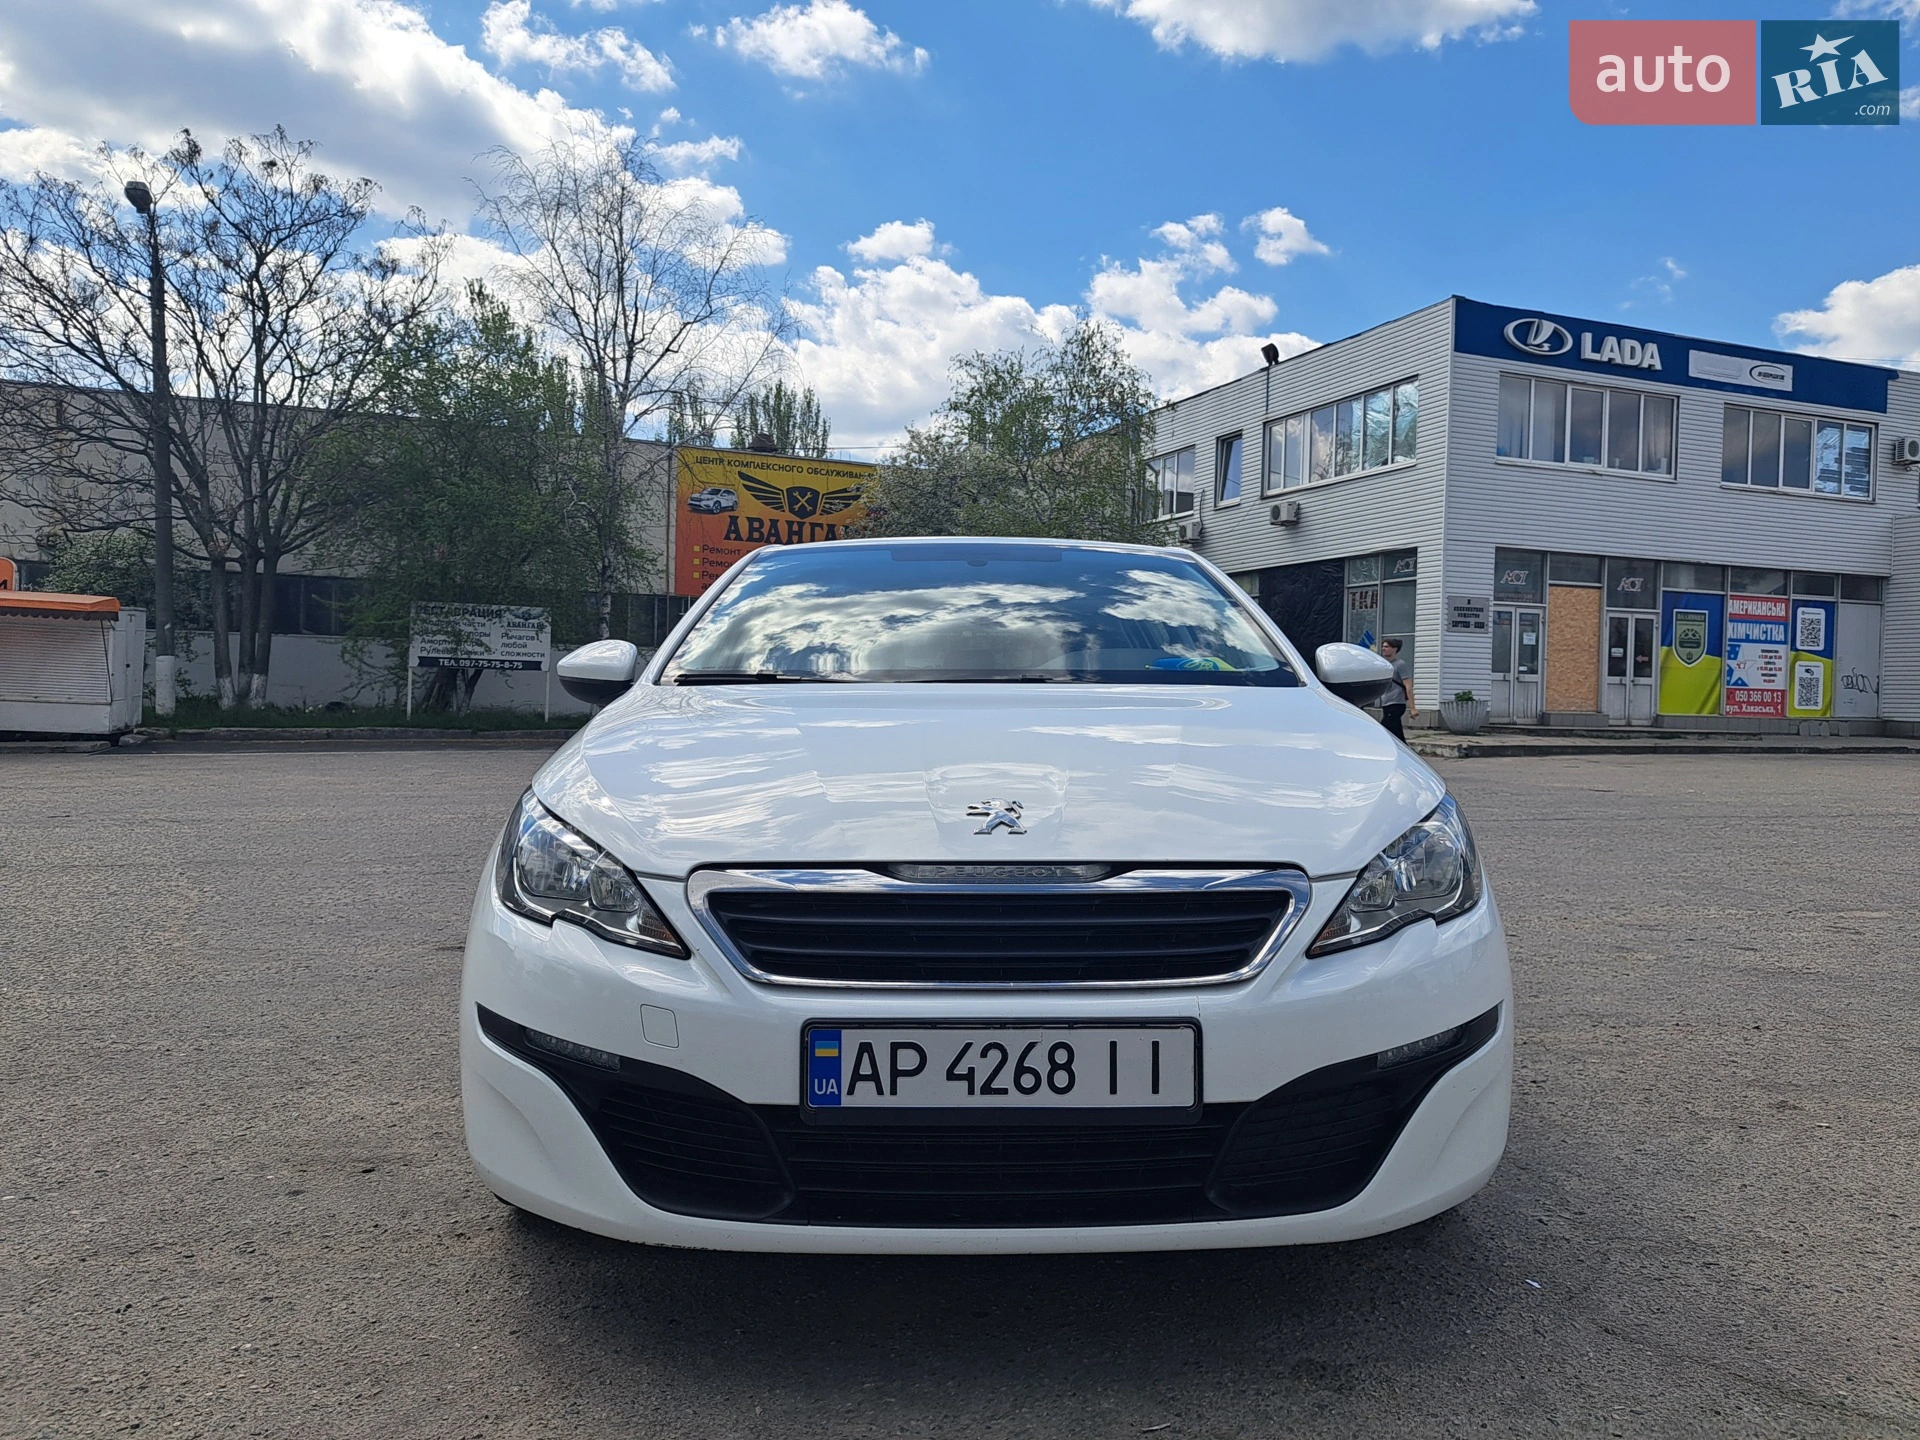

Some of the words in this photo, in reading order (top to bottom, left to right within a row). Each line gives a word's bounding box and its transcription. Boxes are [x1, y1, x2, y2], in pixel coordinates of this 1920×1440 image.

[1580, 331, 1662, 371] LADA
[696, 455, 725, 466] ЦЕНТР
[727, 459, 804, 474] КОМПЛЕКСНОГО
[724, 515, 850, 544] АВАНГА
[702, 544, 741, 556] Ремонт
[1728, 599, 1786, 617] АМЕРИКАНСЬКА
[501, 632, 536, 642] Рычагов
[501, 641, 527, 649] любой
[500, 650, 546, 659] сложности
[438, 658, 458, 667] ТЕЛ.
[459, 659, 523, 669] 097-75-75-8-75
[1735, 690, 1748, 702] 050
[1749, 691, 1762, 702] 366
[1763, 691, 1772, 703] 00
[1773, 691, 1782, 703] 13
[846, 1040, 928, 1096] AP
[945, 1040, 1076, 1096] 4268
[814, 1078, 839, 1095] UA
